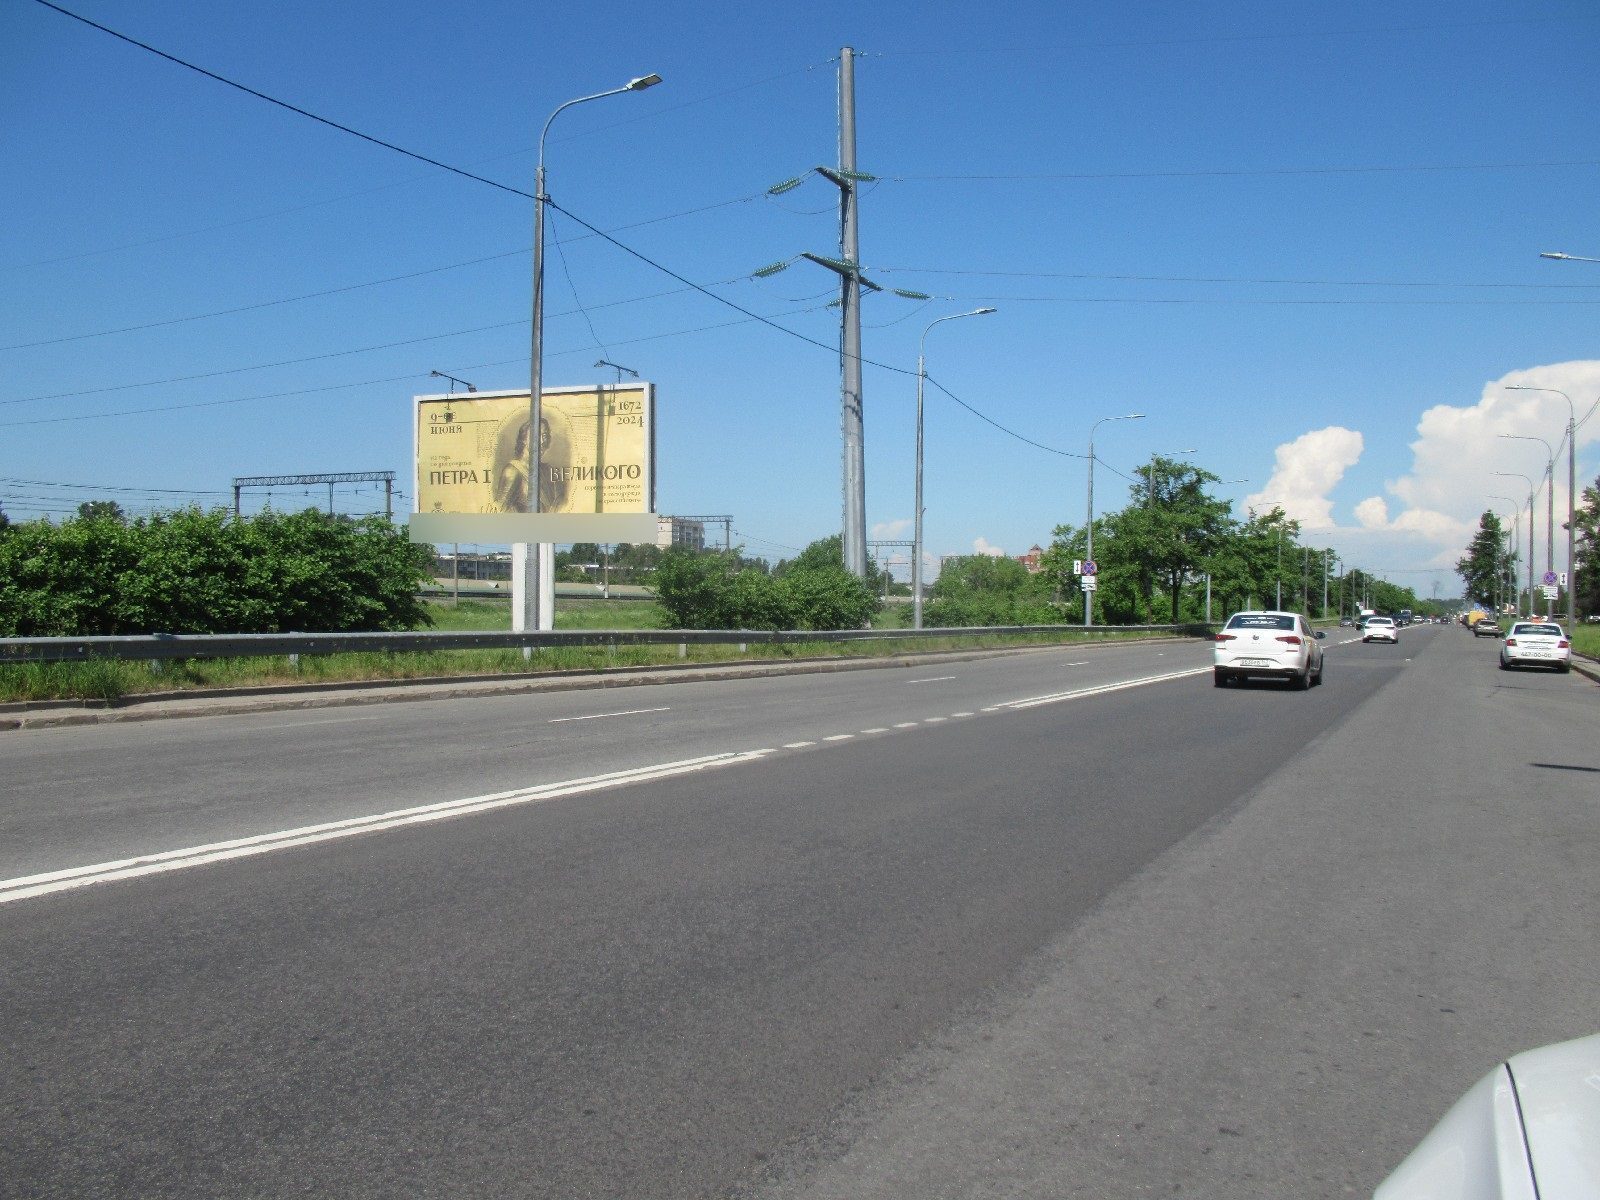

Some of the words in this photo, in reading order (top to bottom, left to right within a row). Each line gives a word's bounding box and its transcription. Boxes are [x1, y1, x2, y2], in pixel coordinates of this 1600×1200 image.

[618, 401, 642, 414] 1672
[617, 416, 644, 427] 2024
[430, 425, 462, 435] ИЮНЯ
[430, 469, 478, 485] ПЕТРА
[550, 464, 642, 483] ВЕЛИКОГО
